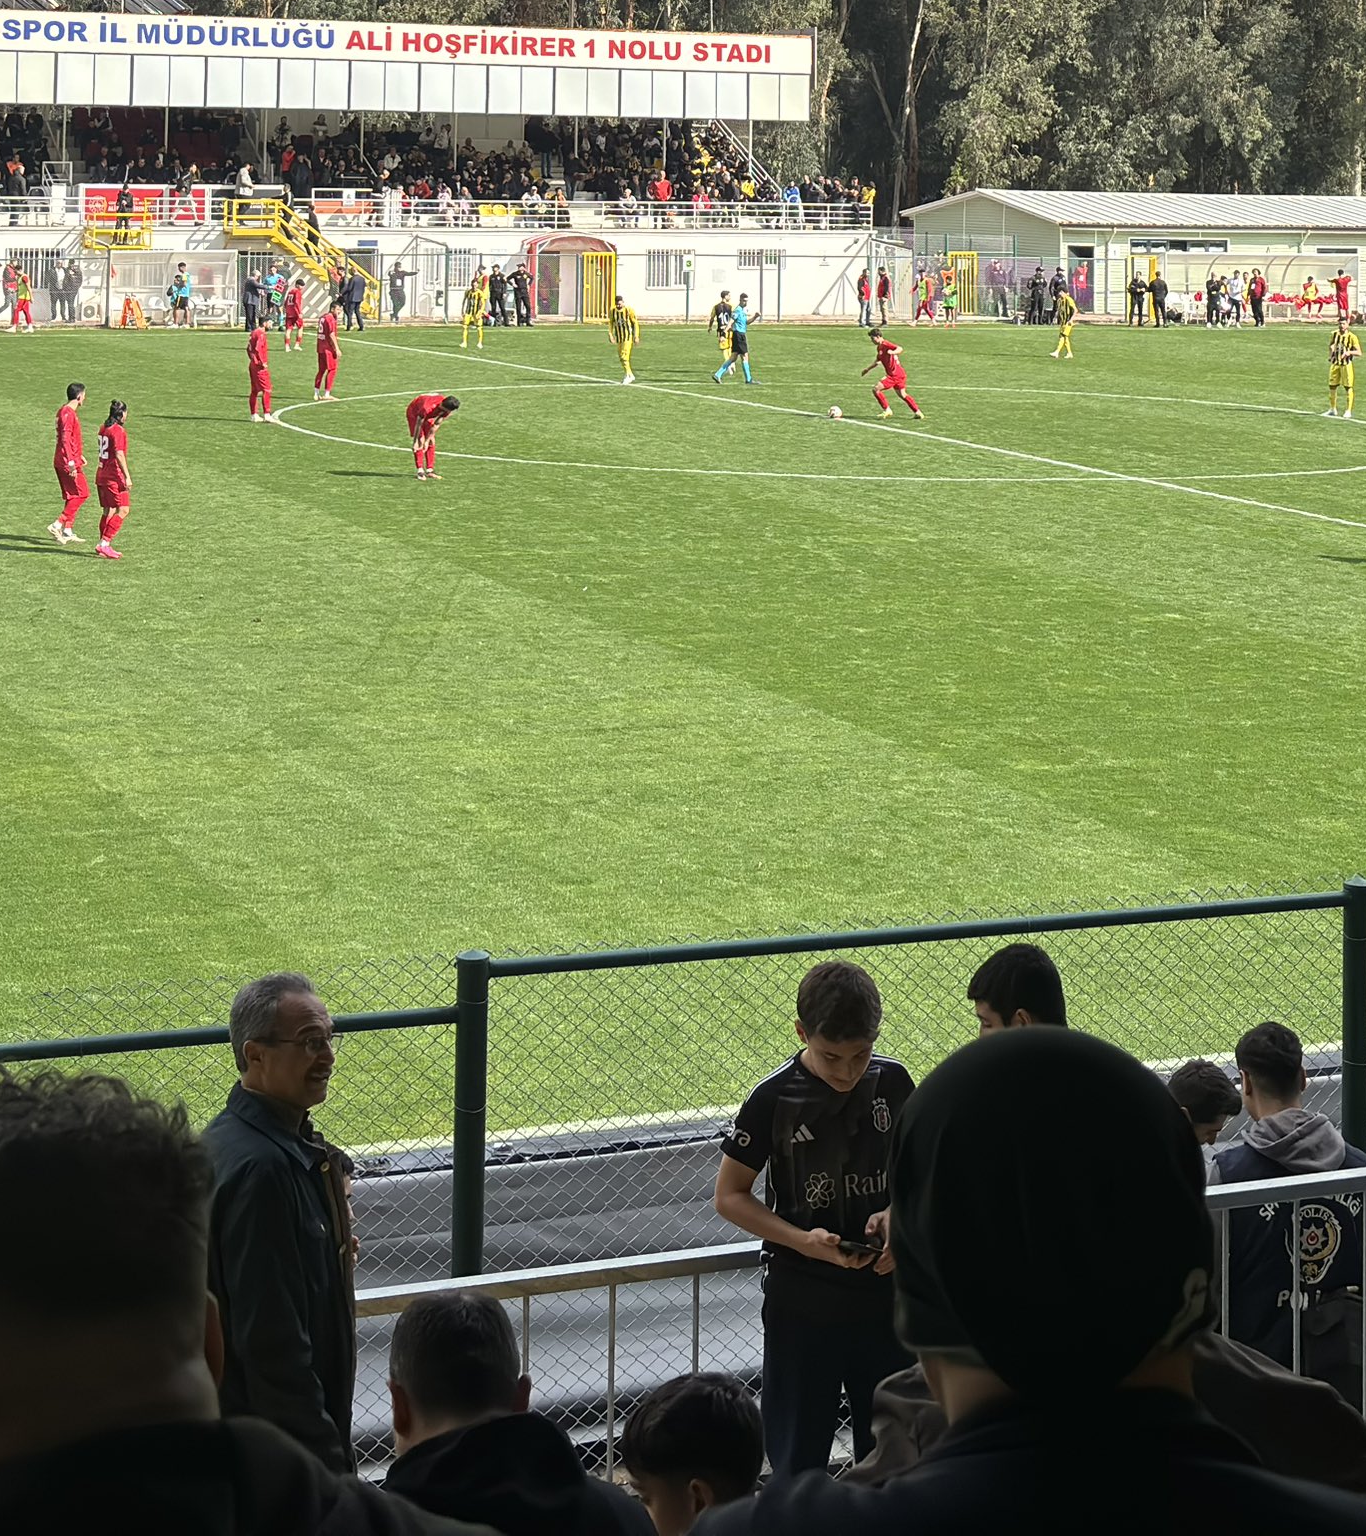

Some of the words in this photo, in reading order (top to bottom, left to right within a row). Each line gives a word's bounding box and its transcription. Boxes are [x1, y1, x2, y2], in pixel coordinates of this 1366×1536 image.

[2, 18, 88, 43] SPOR
[99, 16, 127, 43] İL
[136, 18, 335, 49] MÜDÜRLÜĞÜ
[346, 26, 392, 52] ALİ
[402, 29, 576, 59] HOŞFİKİRER
[584, 39, 595, 58] 1
[608, 40, 682, 61] NOLU
[693, 42, 771, 63] STADI
[718, 312, 730, 325] 10
